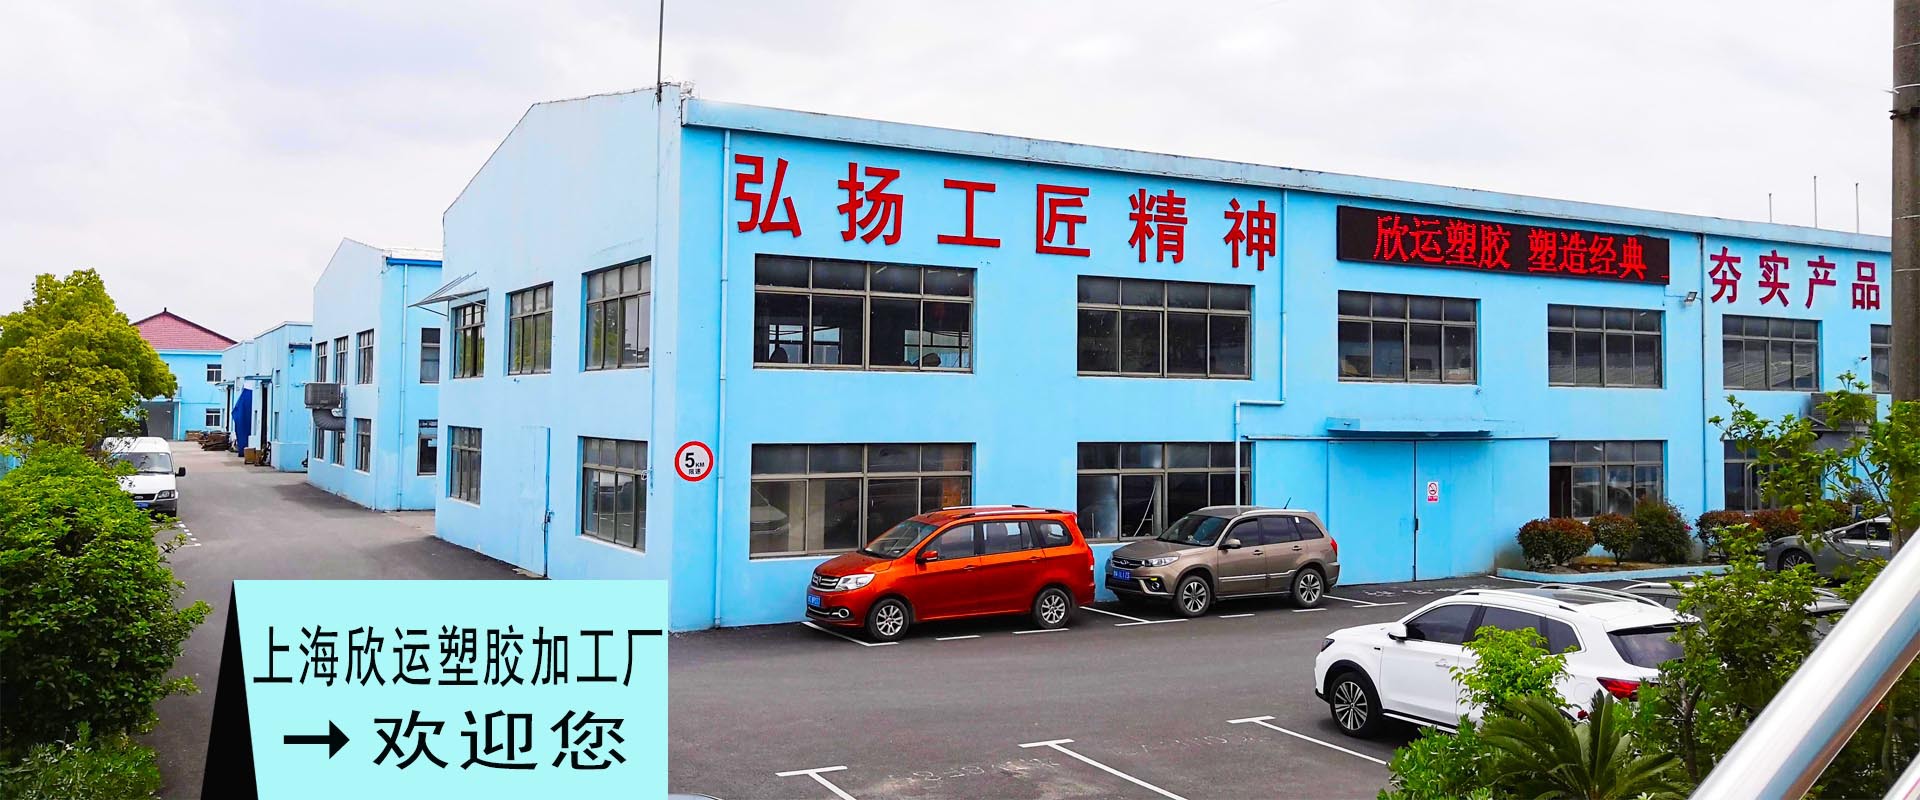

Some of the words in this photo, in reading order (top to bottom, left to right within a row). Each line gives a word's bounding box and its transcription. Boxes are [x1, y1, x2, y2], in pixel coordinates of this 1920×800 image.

[735, 153, 1277, 271] 弘扬工匠精神
[1373, 213, 1511, 269] 欣运塑胶
[1527, 227, 1648, 280] 塑造经典
[1708, 246, 1880, 310] 夯实产品
[685, 452, 695, 468] 5
